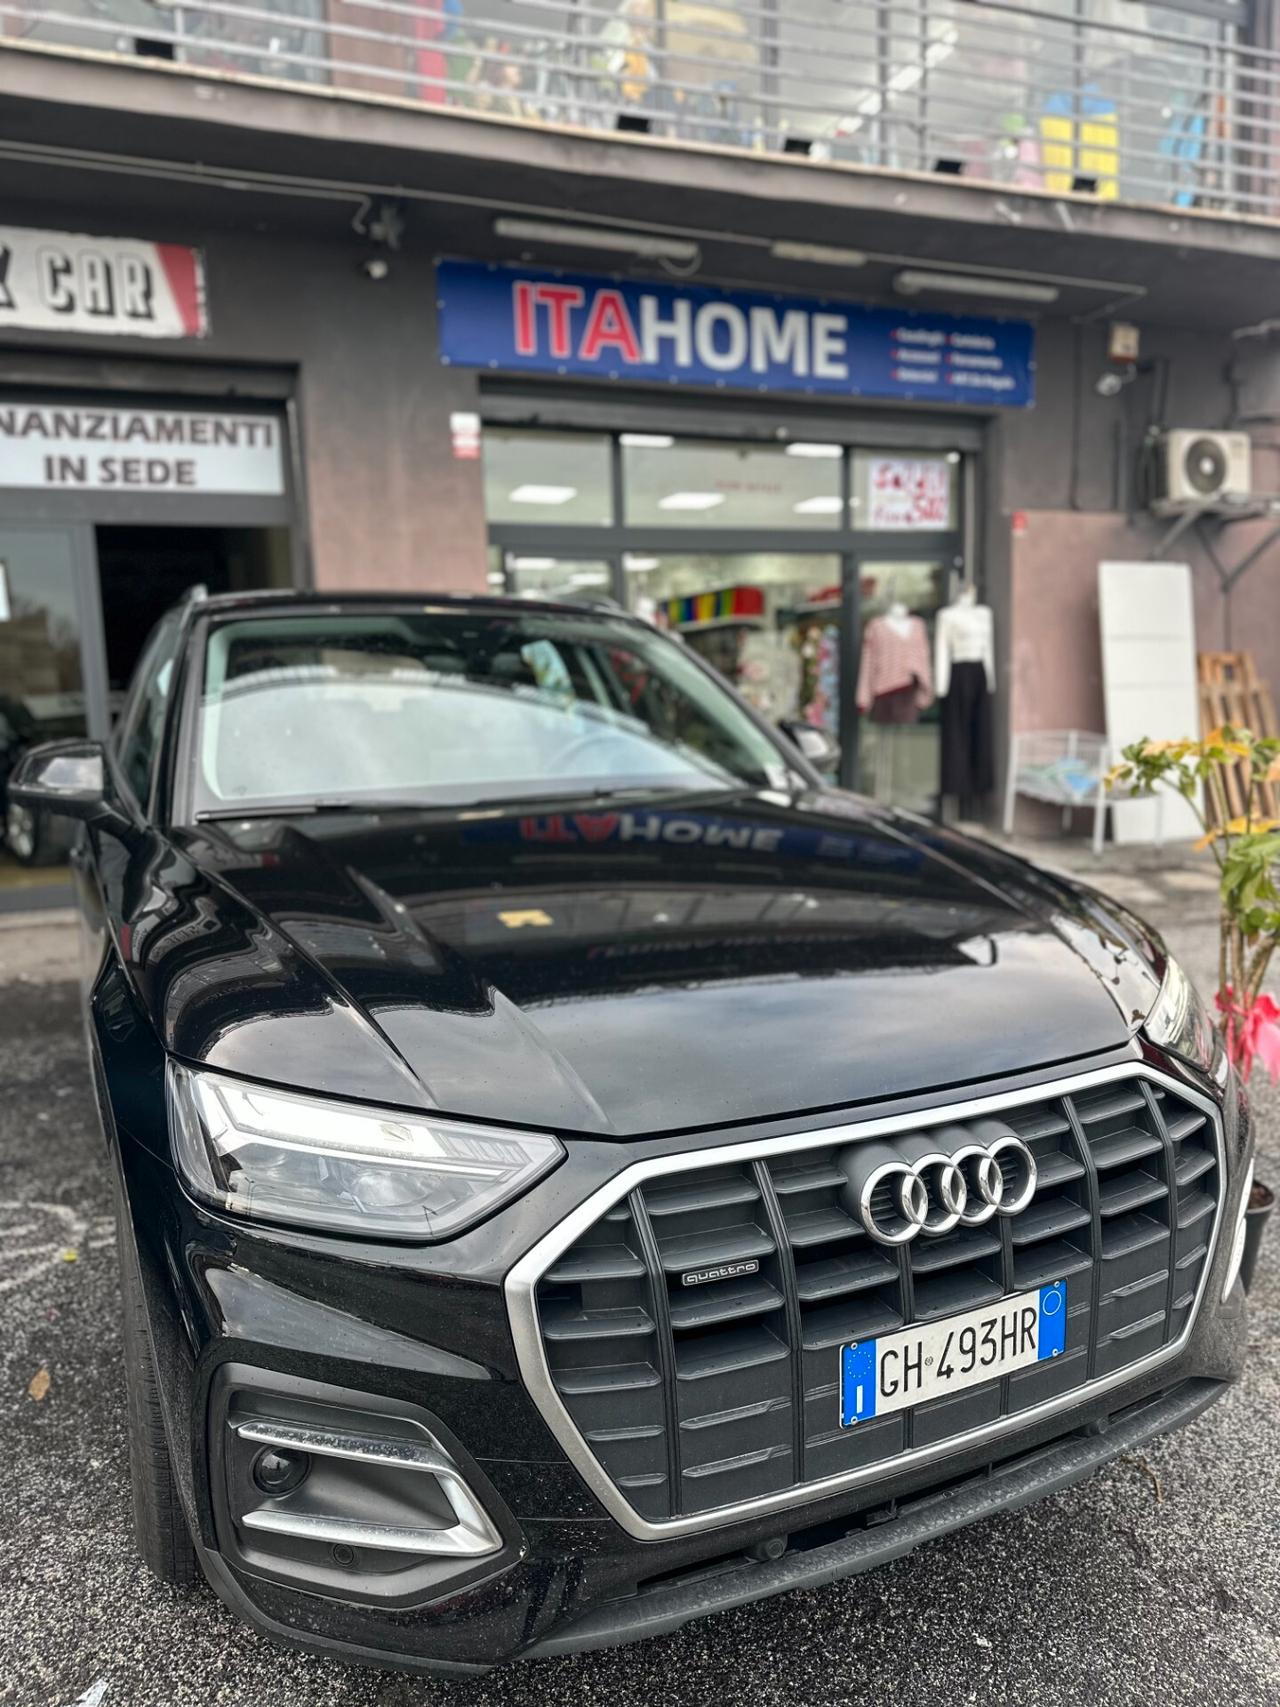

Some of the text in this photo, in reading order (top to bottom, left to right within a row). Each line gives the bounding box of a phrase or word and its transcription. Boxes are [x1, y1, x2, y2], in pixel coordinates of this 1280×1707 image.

[39, 250, 153, 319] CAR
[512, 281, 849, 378] ITAHOME
[44, 455, 196, 486] IN SEDE
[685, 1262, 757, 1284] quattro
